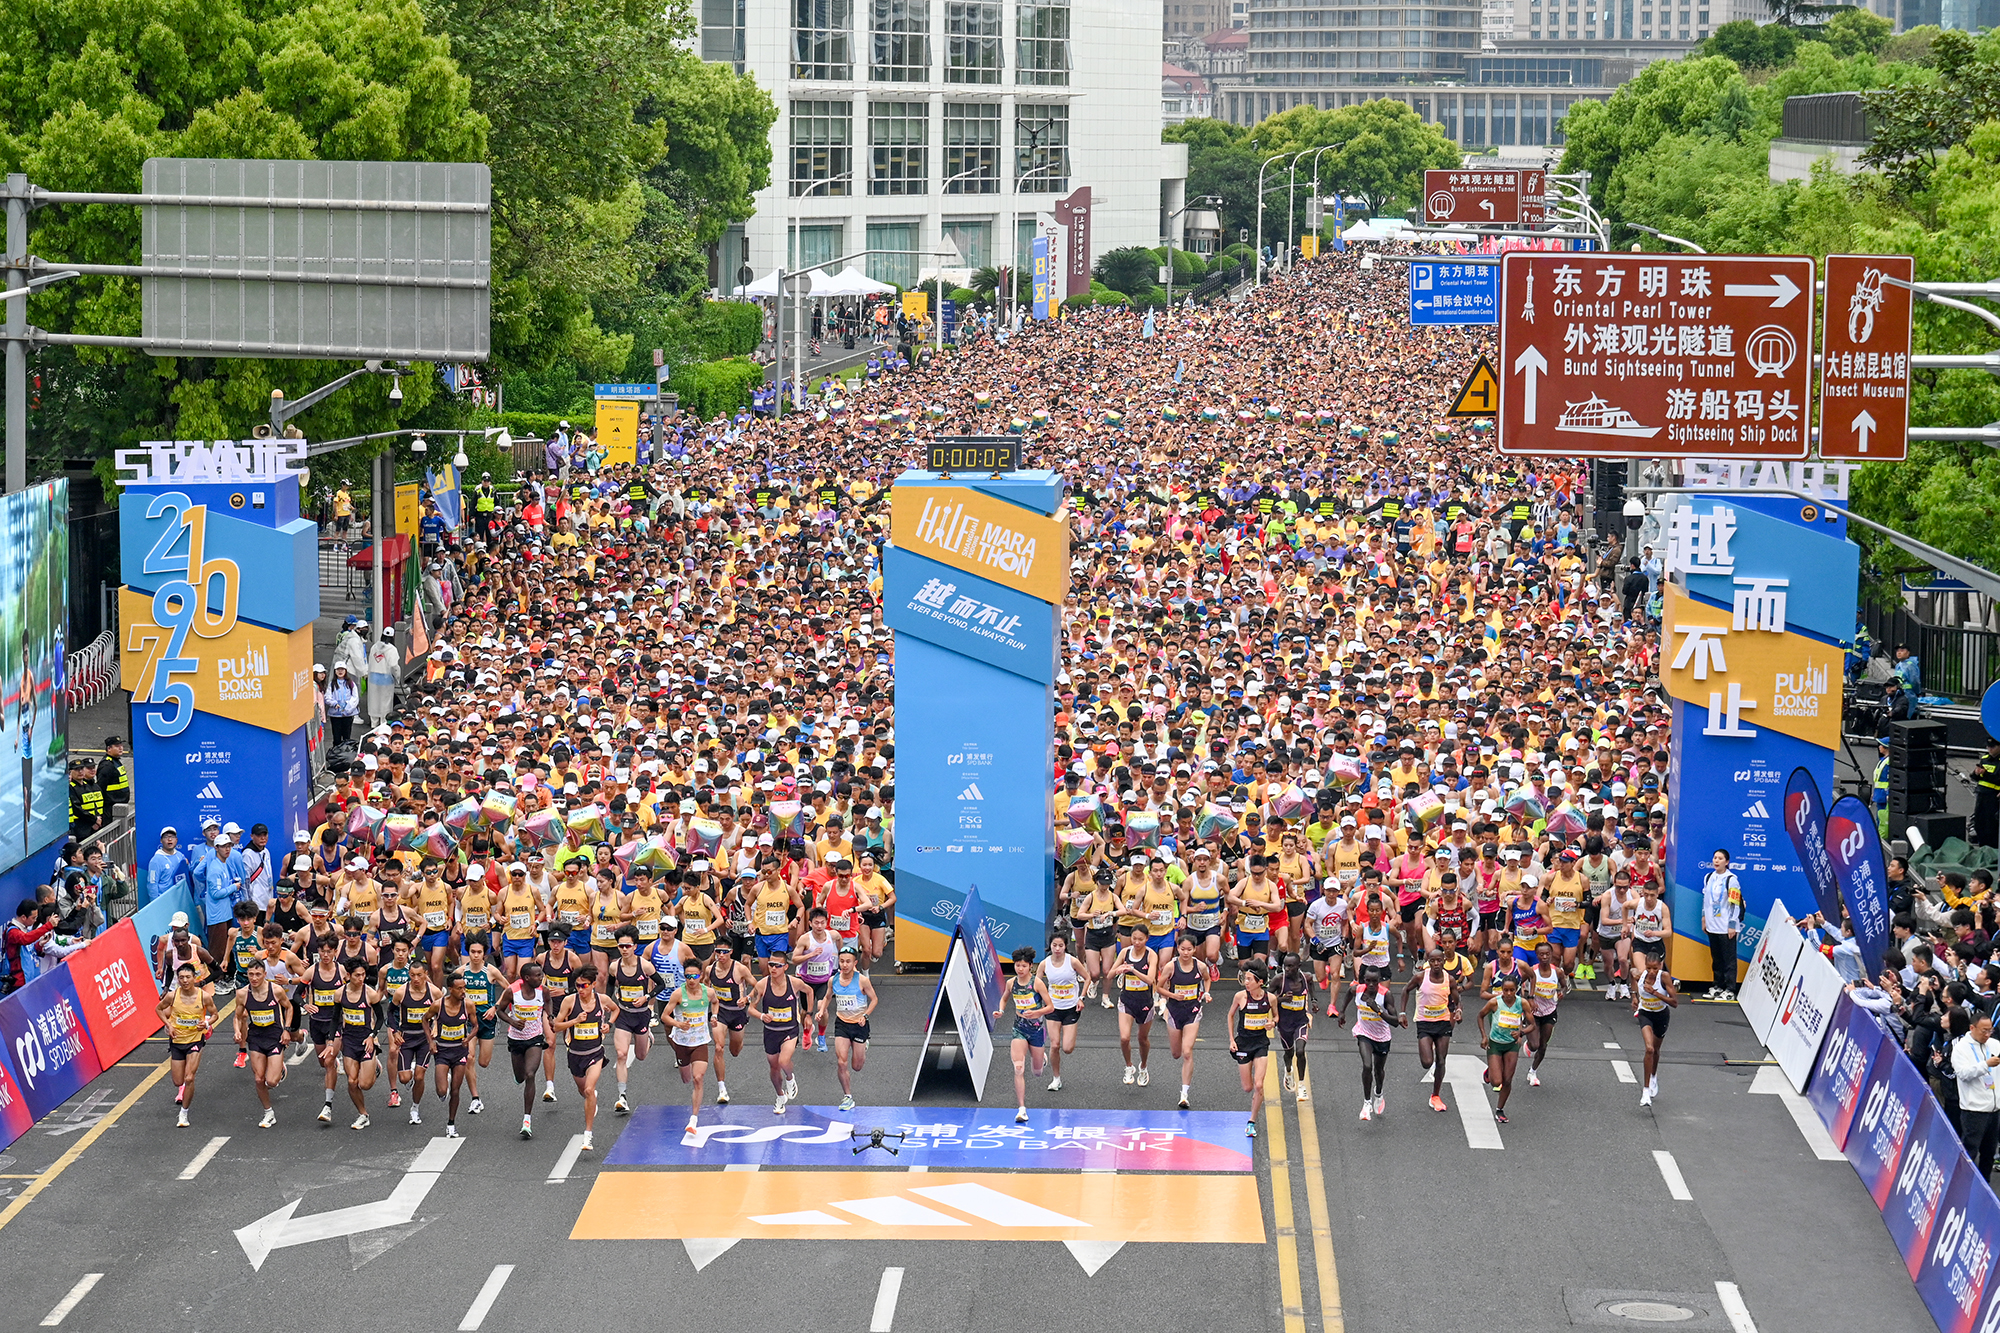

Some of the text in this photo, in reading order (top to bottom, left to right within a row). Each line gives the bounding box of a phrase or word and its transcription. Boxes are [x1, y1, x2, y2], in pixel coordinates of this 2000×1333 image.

[1449, 174, 1515, 185] 外滩观光隧道
[1439, 266, 1489, 277] 东方明珠
[1553, 264, 1712, 298] 东方明珠
[1433, 295, 1493, 307] 国际会议中心
[1554, 300, 1712, 319] Oriental Pearl Tower
[1564, 323, 1736, 357] 外滩观光隧道
[1564, 358, 1735, 382] Bund Sightseeing Tunnel
[1826, 351, 1906, 379] 大自然昆虫馆
[1665, 388, 1799, 421] 游船码头
[1825, 383, 1905, 398] Insect Museum
[1667, 423, 1798, 445] Sightseeing Ship Dock
[933, 449, 1010, 468] 0:00:02
[981, 522, 1036, 559] MARA
[977, 541, 1033, 578] THON
[907, 601, 1027, 650] EVER BEYOND, ALWAYS RUN
[218, 680, 262, 693] DONG
[219, 691, 263, 701] SHANGHAI
[1774, 695, 1818, 708] DONG
[1773, 708, 1818, 717] SHANGHAI
[959, 816, 982, 824] FSG
[1851, 870, 1875, 943] SPD BANK
[1858, 859, 1885, 935] 浦发银行
[37, 998, 77, 1045] 浦发银行
[48, 1031, 84, 1070] SPD BANK
[1840, 1037, 1868, 1088] 浦发银行
[1832, 1071, 1855, 1113] SPD BANK
[897, 1123, 1187, 1141] 浦发银行
[1881, 1090, 1910, 1146] 浦发银行
[899, 1138, 1174, 1152] SPD BANK
[1873, 1127, 1898, 1173] SPD BANK
[1918, 1151, 1945, 1211] 浦发银行
[1908, 1190, 1931, 1239] SPD BANK
[1958, 1221, 1992, 1288] 浦发银行
[1948, 1262, 1977, 1319] SPD BANK
